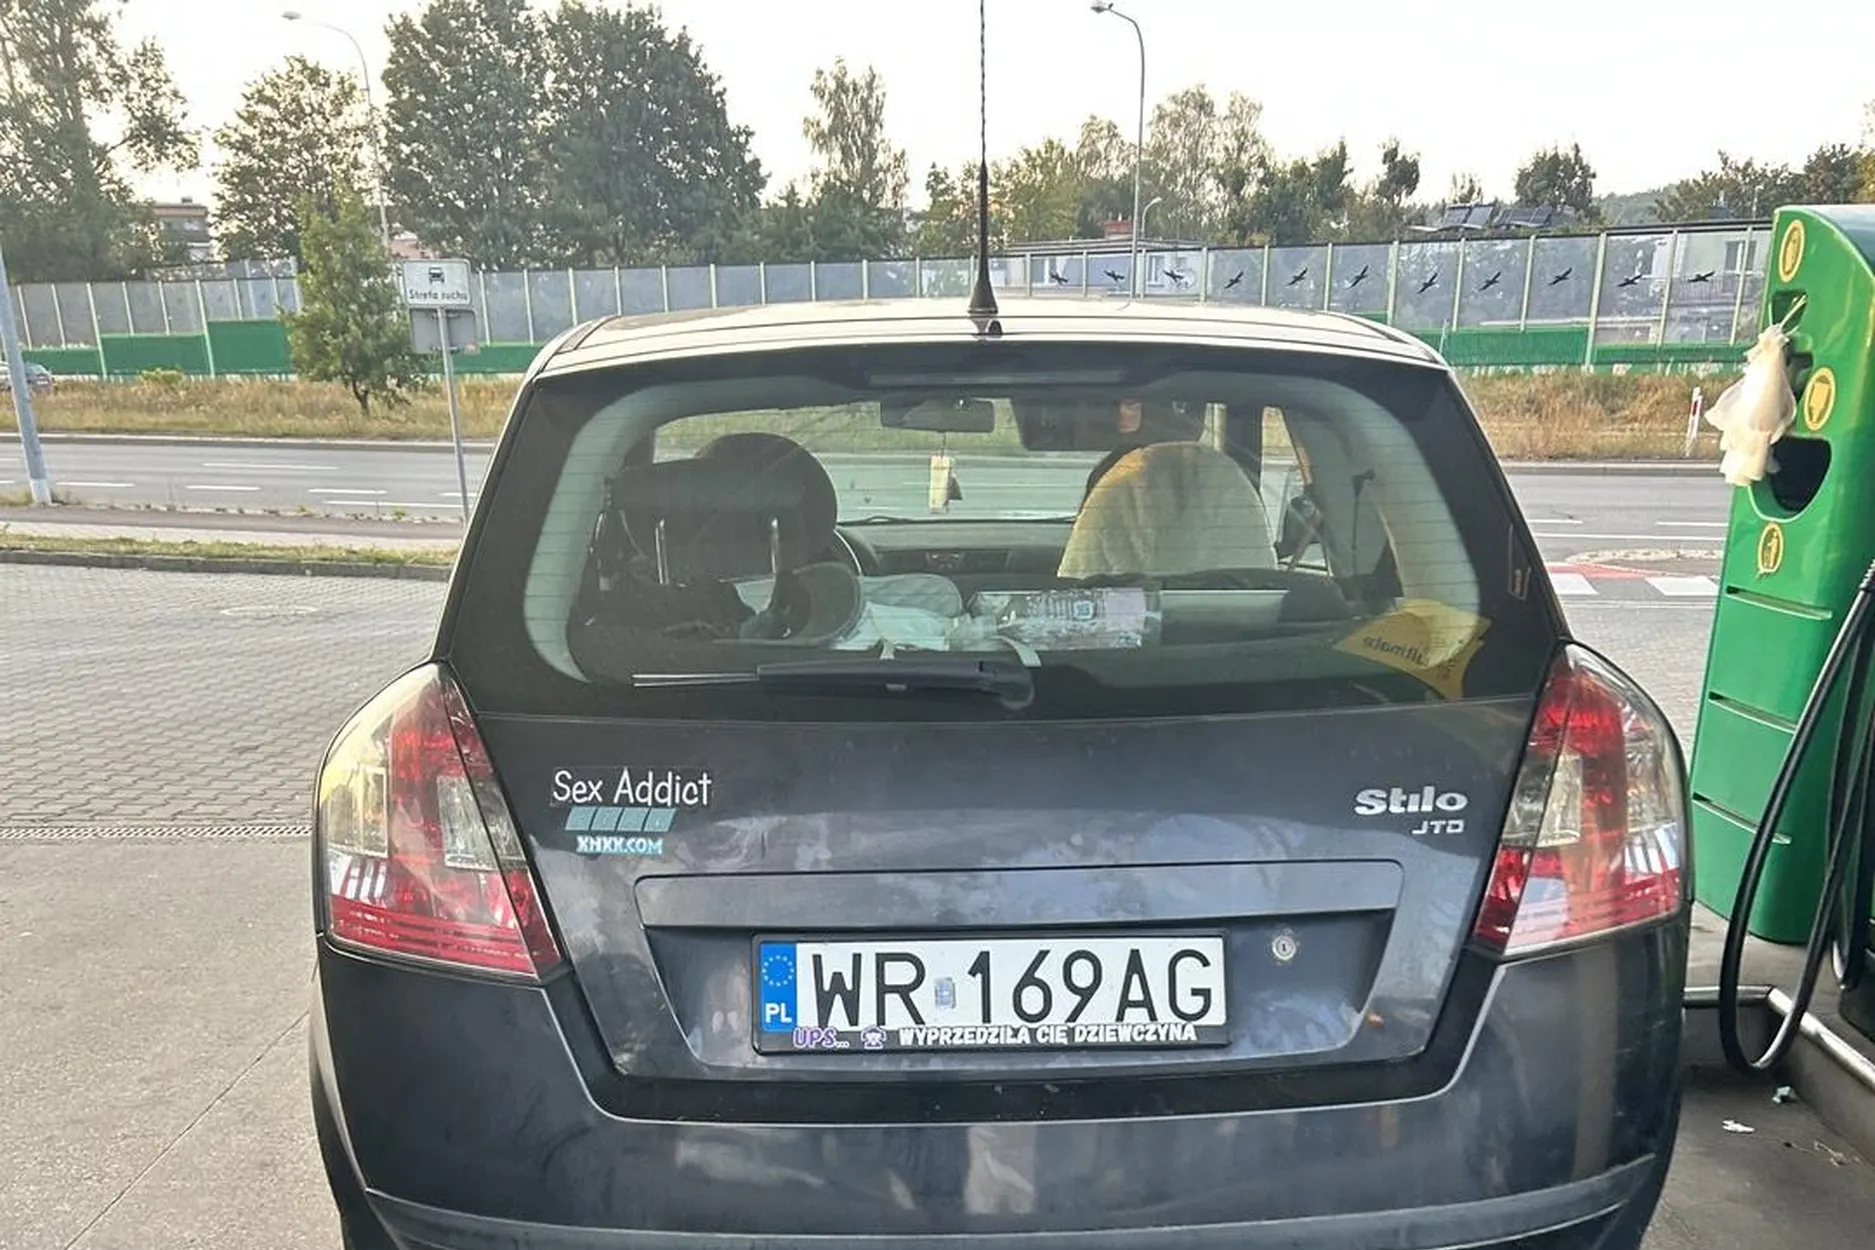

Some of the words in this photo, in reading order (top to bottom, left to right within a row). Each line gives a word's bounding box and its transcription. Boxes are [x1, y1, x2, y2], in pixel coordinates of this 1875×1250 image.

[409, 289, 438, 299] Strefa
[553, 769, 603, 803] Sex
[613, 766, 712, 806] Addict
[1354, 785, 1468, 816] Stilo
[1411, 819, 1465, 834] JTD
[576, 835, 664, 855] XNXX.COM
[812, 951, 925, 1027] WR
[967, 948, 1212, 1024] 169AG
[765, 1003, 792, 1023] PL
[899, 1025, 1031, 1046] WYPRZEDZIŁA
[1036, 1024, 1069, 1045] CIĘ
[1074, 1022, 1197, 1043] DZIEWCZYNA
